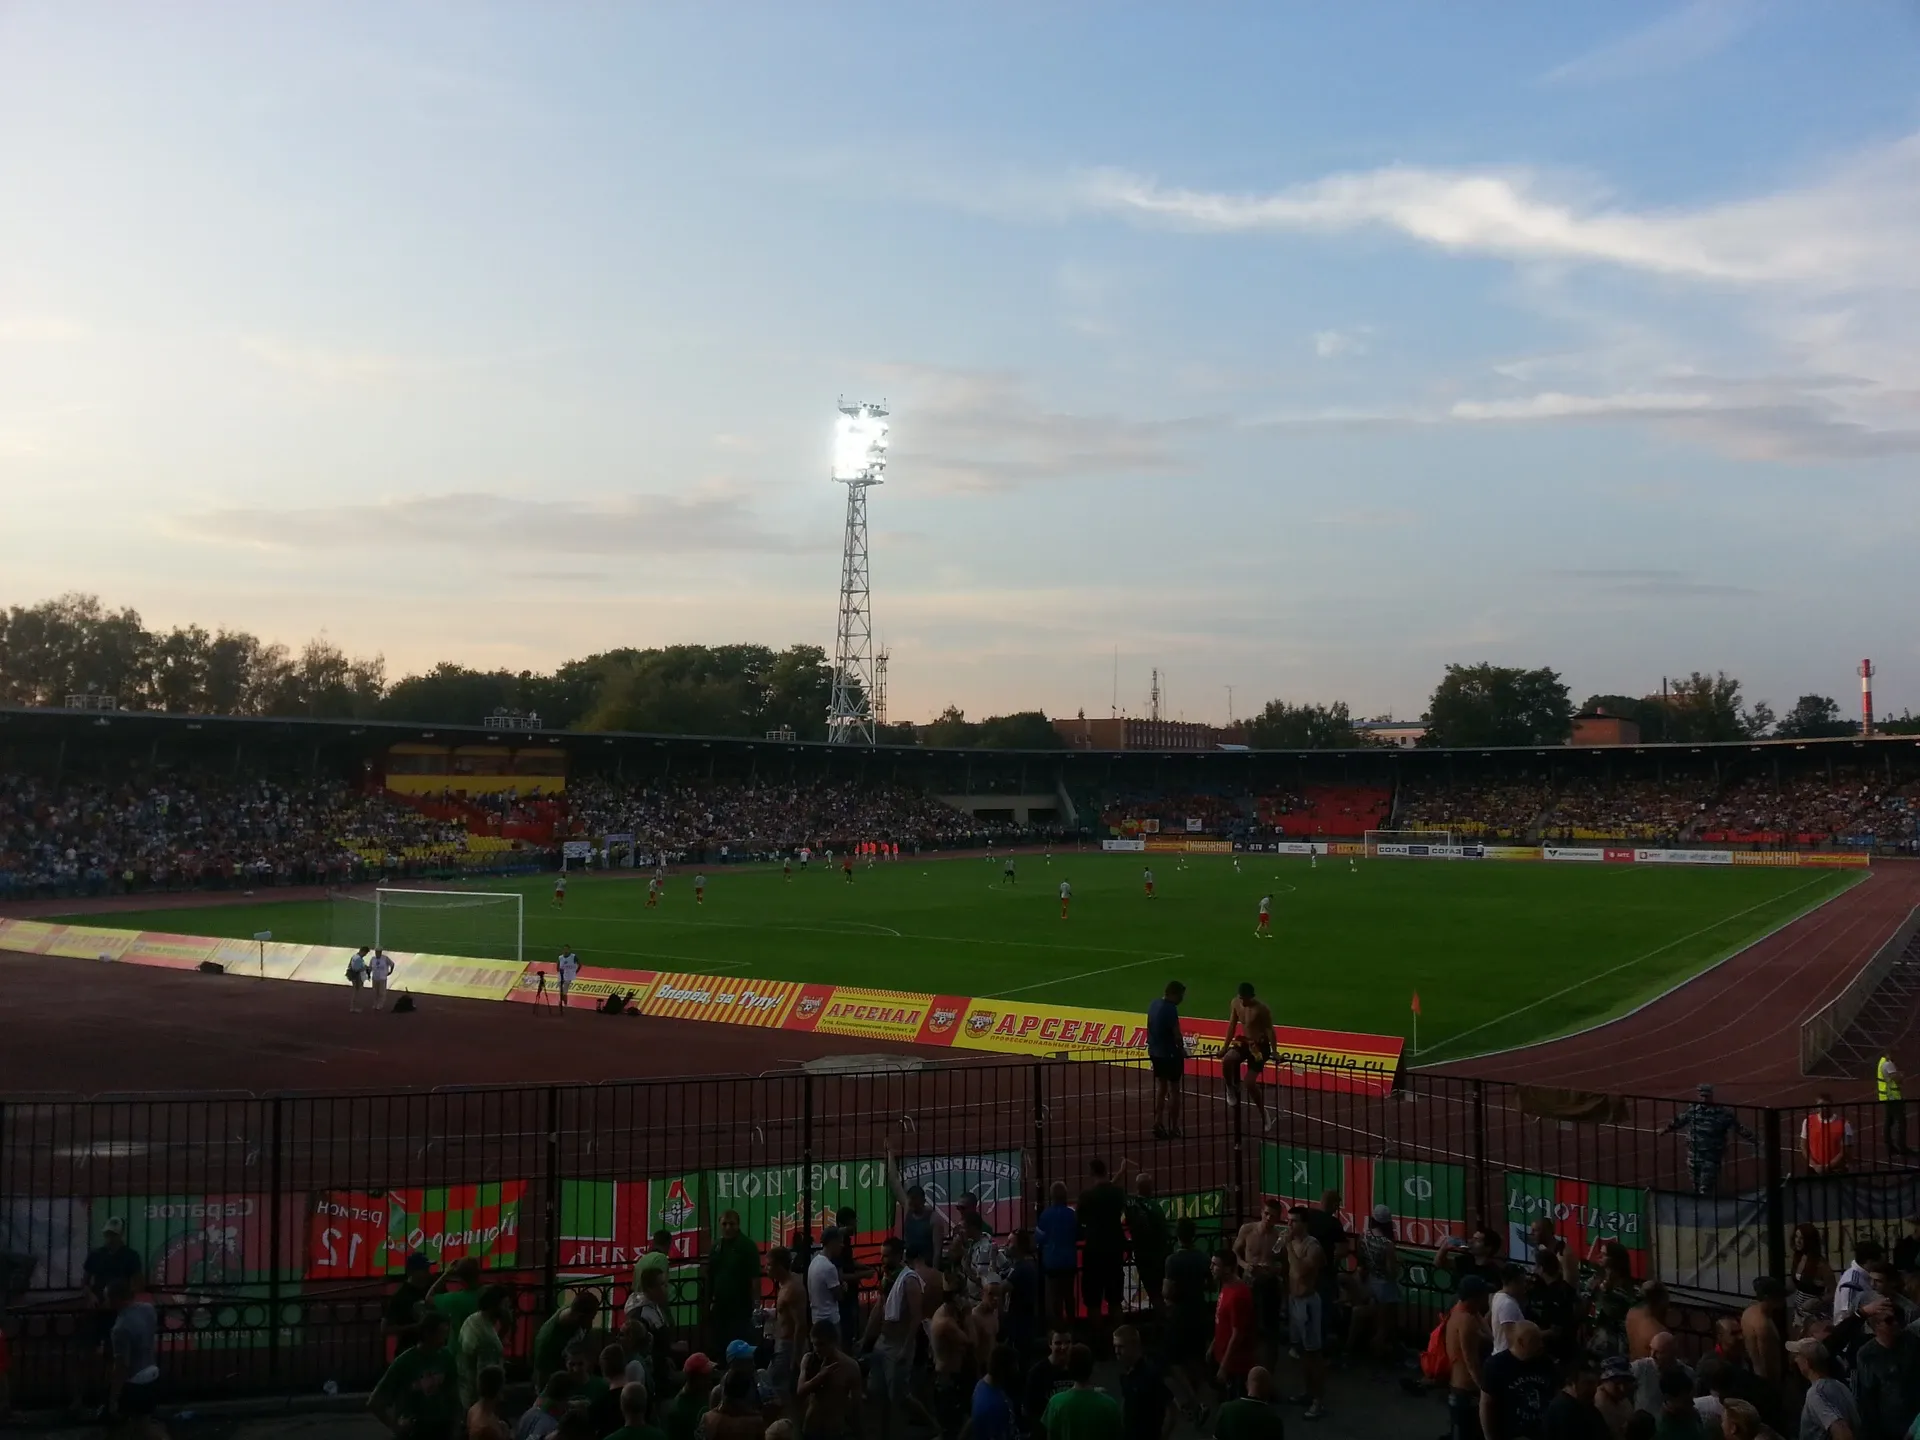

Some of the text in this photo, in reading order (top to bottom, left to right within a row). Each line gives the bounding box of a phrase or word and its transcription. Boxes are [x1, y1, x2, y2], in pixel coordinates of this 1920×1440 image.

[655, 984, 710, 1004] Вперёд,
[714, 993, 736, 1004] за
[737, 991, 784, 1011] Тулу!
[825, 1003, 922, 1025] АРСЕНАЛ
[994, 1013, 1148, 1049] АРСЕНАЛ
[990, 1035, 1069, 1050] ПРОФЕССИОНАЛЬНЫЙ
[1071, 1043, 1124, 1054] ФУТБОЛЬНЫЙ
